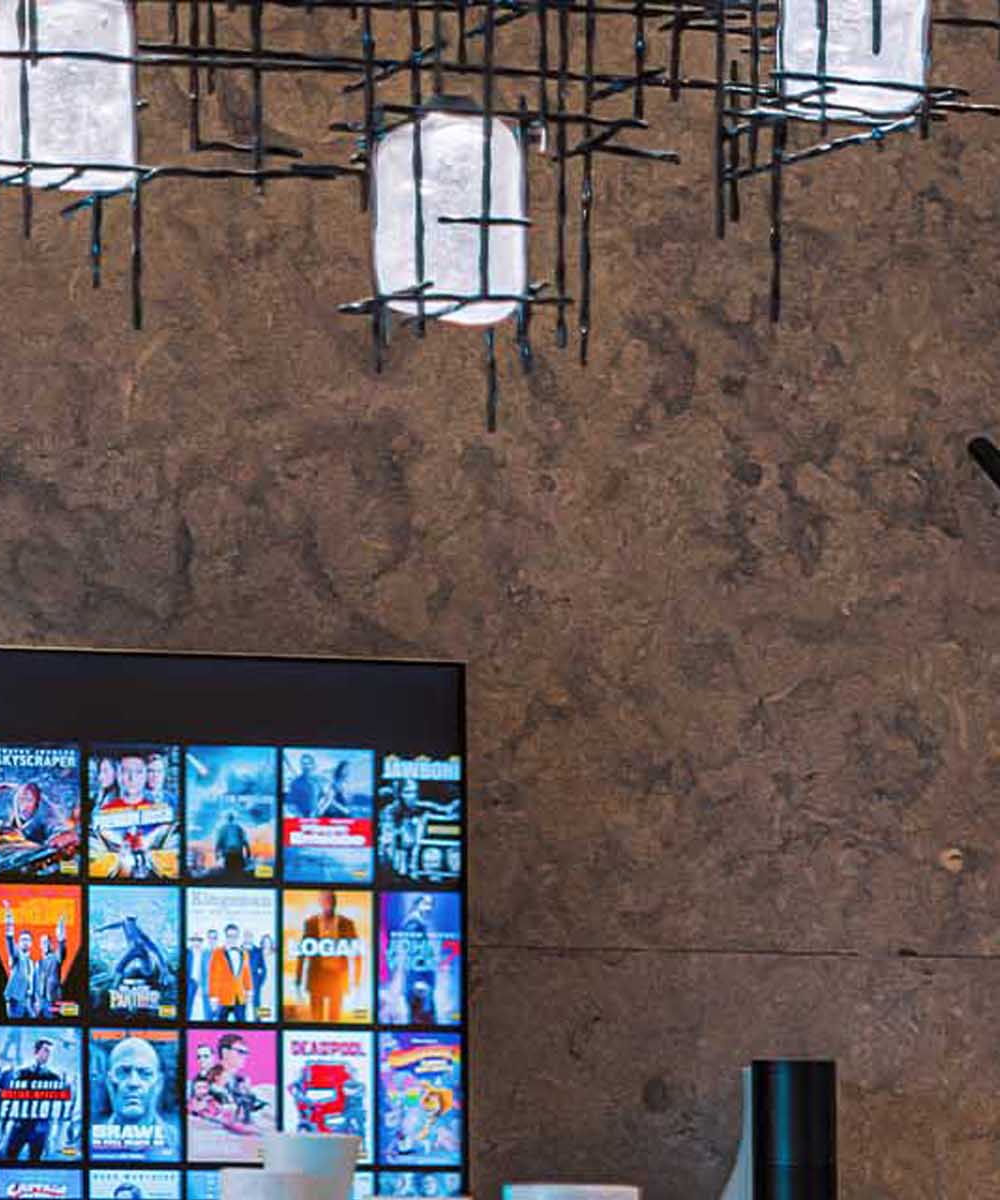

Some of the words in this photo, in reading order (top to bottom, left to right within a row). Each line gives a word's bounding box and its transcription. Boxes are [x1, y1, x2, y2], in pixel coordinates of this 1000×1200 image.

[288, 937, 366, 958] LOGAN
[0, 1100, 74, 1119] FALLOUT
[92, 1124, 164, 1139] BRAWL
